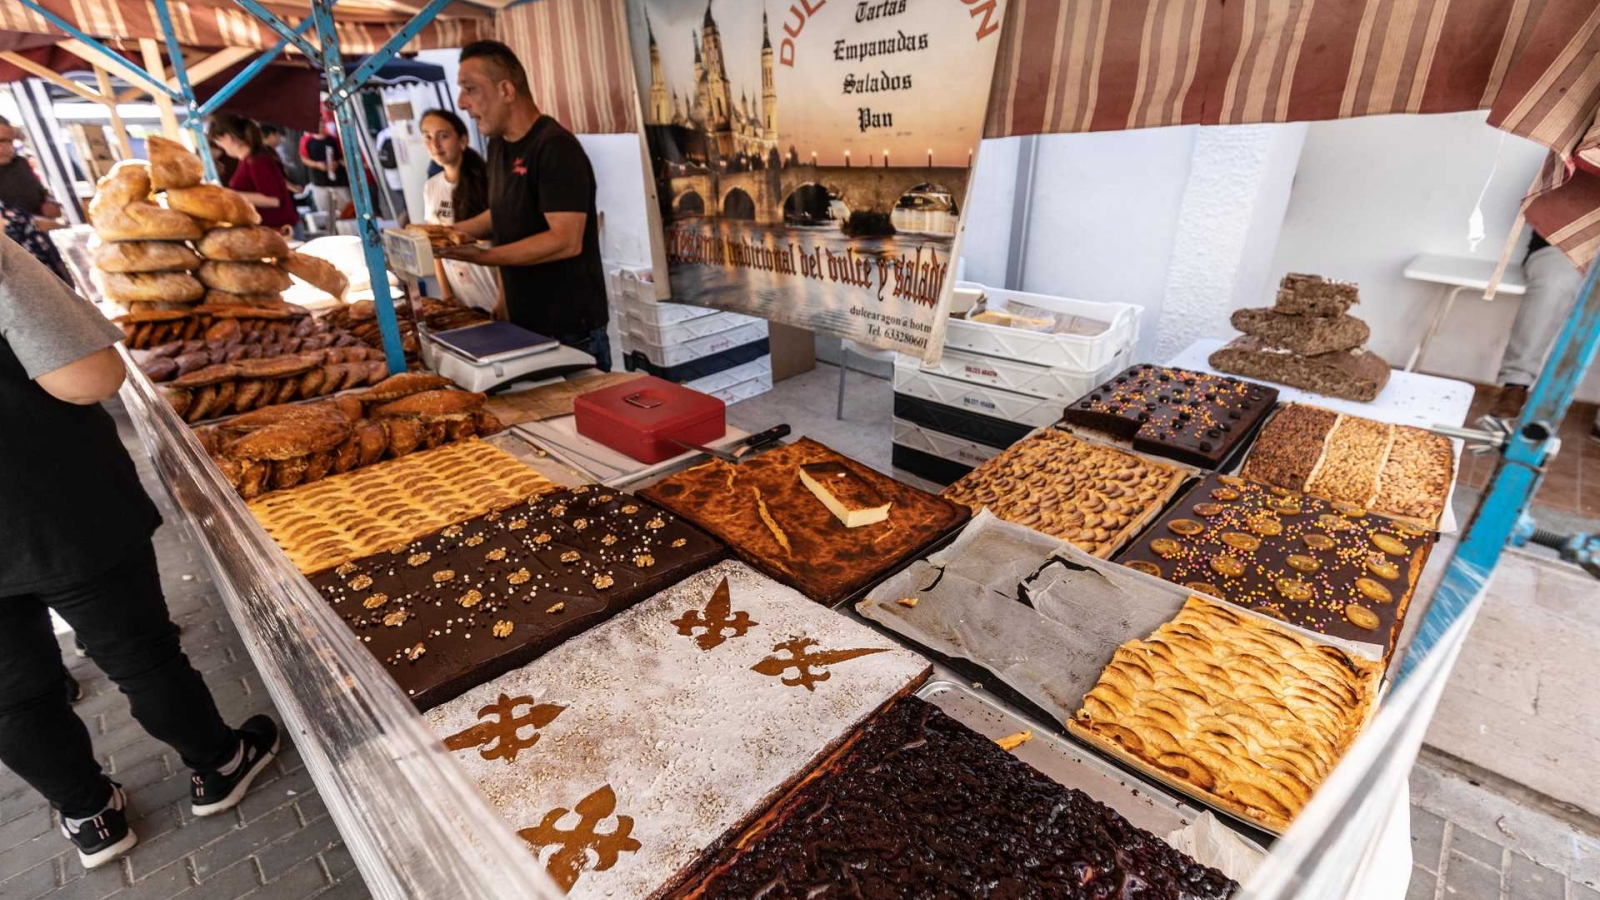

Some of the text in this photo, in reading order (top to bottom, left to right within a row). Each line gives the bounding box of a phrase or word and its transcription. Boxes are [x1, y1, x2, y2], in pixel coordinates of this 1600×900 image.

[855, 0, 907, 23] Tartas
[959, 0, 999, 42] N
[833, 30, 929, 62] Empanadas
[842, 70, 913, 95] Salados
[857, 107, 893, 133] Pan
[798, 244, 824, 281] del
[825, 247, 873, 290] dulce
[867, 323, 882, 337] Tel.
